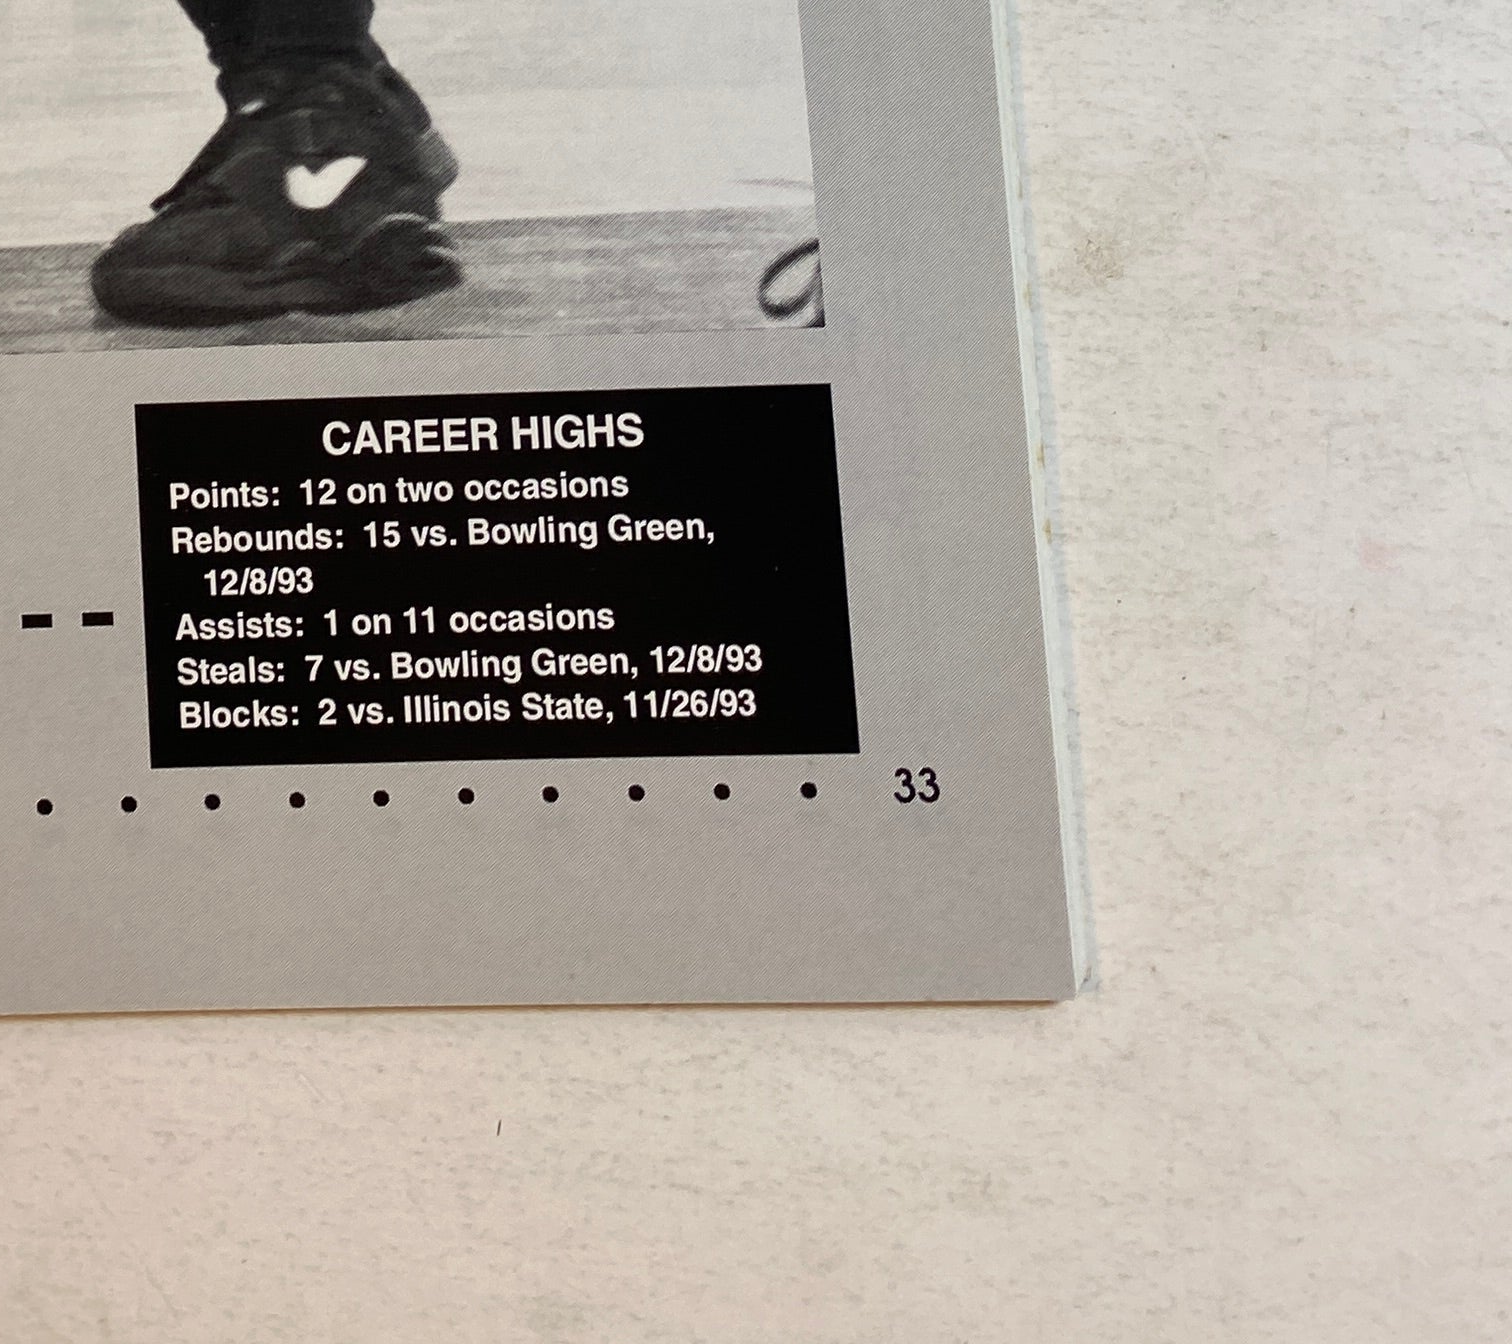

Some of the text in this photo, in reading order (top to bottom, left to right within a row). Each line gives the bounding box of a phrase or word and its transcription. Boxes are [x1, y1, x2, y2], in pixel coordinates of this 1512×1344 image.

[322, 412, 645, 456] CAREER HIGHS
[169, 470, 629, 510] Points: 12 on two occasions
[171, 513, 715, 554] Rebounds: 15 vs. Bowling Green,
[203, 566, 314, 597] 12/8/93
[175, 602, 615, 641] Assists: 1 on 11 occasions
[177, 643, 763, 686] Steals: 7 vs. Bowling Green, 12/8/93
[179, 688, 757, 729] Blocks: 2 vs. Illinois State, 11/26/93
[893, 766, 941, 804] 33
